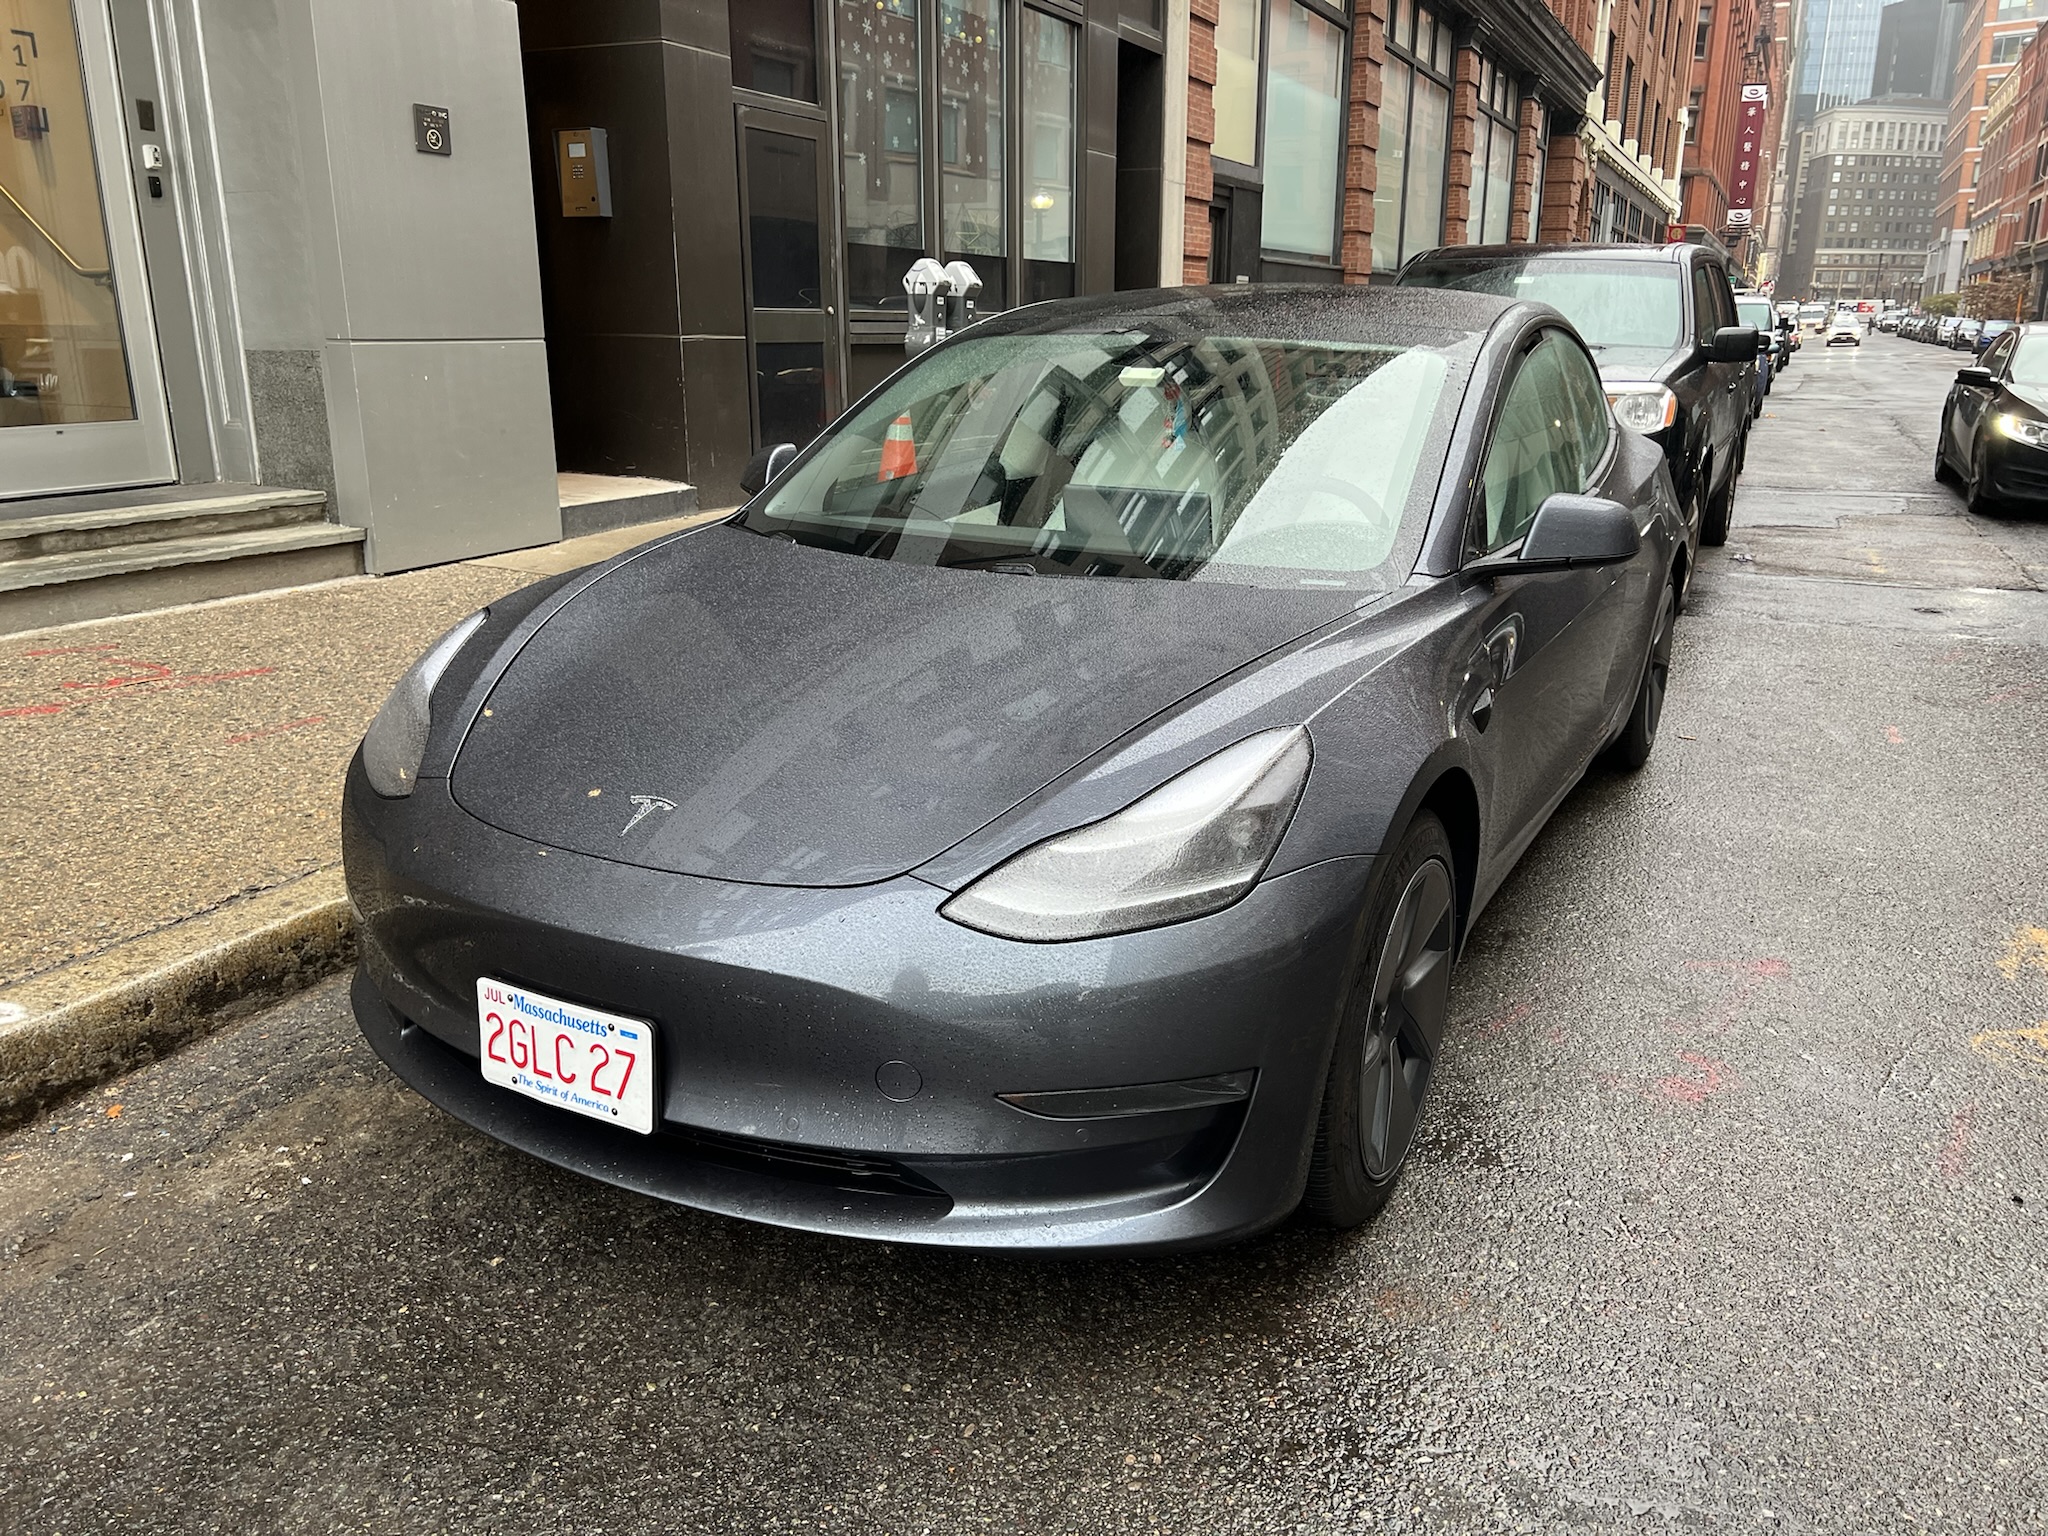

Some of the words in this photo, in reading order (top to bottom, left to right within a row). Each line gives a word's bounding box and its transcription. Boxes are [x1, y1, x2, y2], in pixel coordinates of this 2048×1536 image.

[1838, 302, 1875, 313] FedEx
[484, 987, 505, 1005] JUL
[513, 993, 608, 1037] Massachusetts
[486, 1012, 576, 1084] 2GLC
[589, 1043, 636, 1100] 27
[517, 1073, 533, 1087] The
[535, 1079, 558, 1096] Spirit
[560, 1090, 570, 1100] of
[570, 1092, 609, 1113] America
